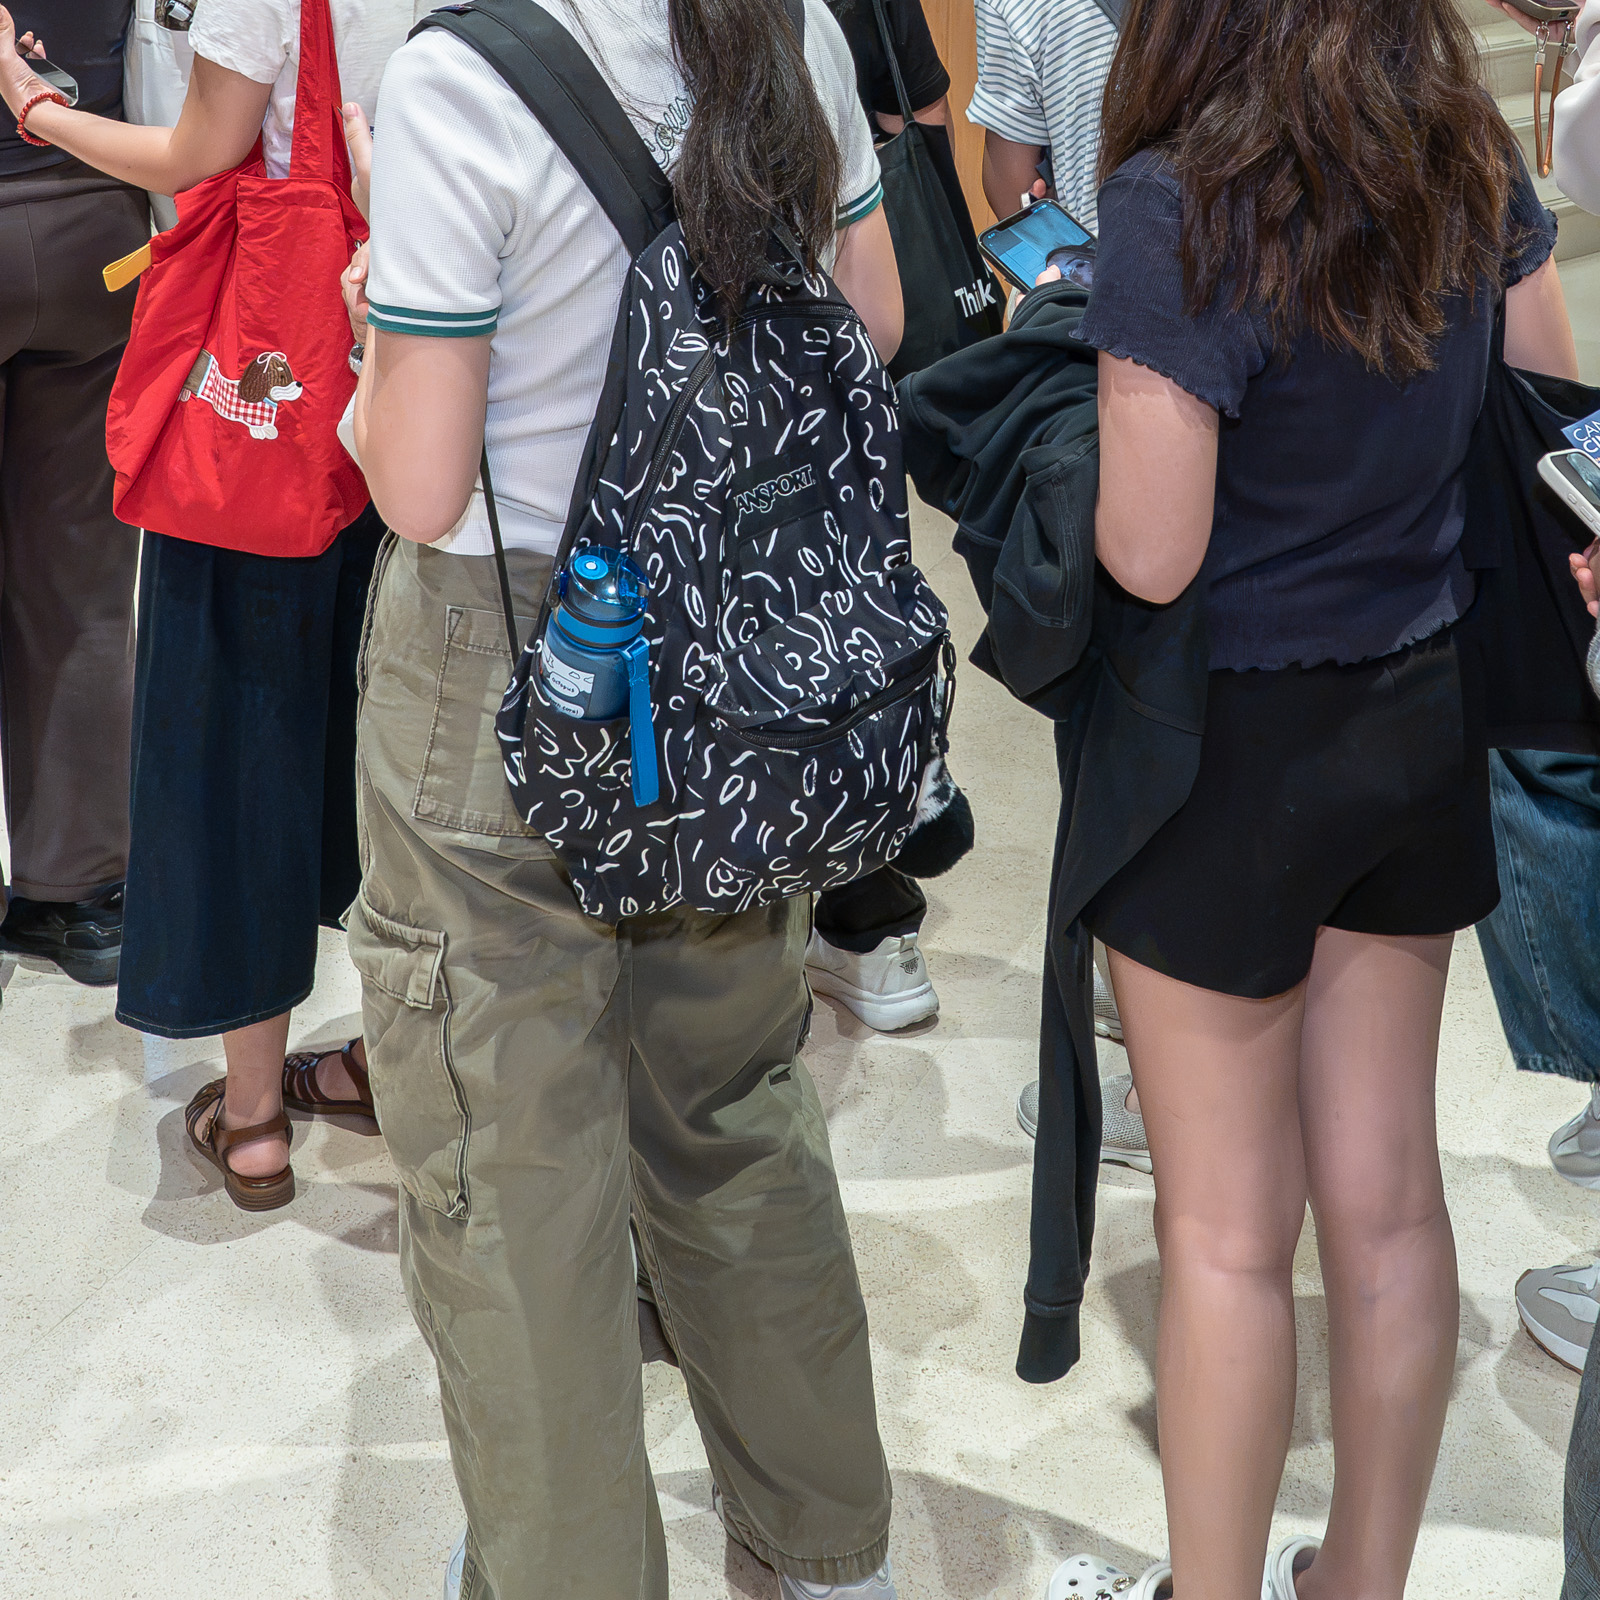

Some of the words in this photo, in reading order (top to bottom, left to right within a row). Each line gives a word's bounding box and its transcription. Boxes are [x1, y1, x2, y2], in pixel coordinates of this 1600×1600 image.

[954, 278, 997, 318] Thik
[733, 463, 813, 537] ANSPORT
[551, 676, 575, 693] octopus
